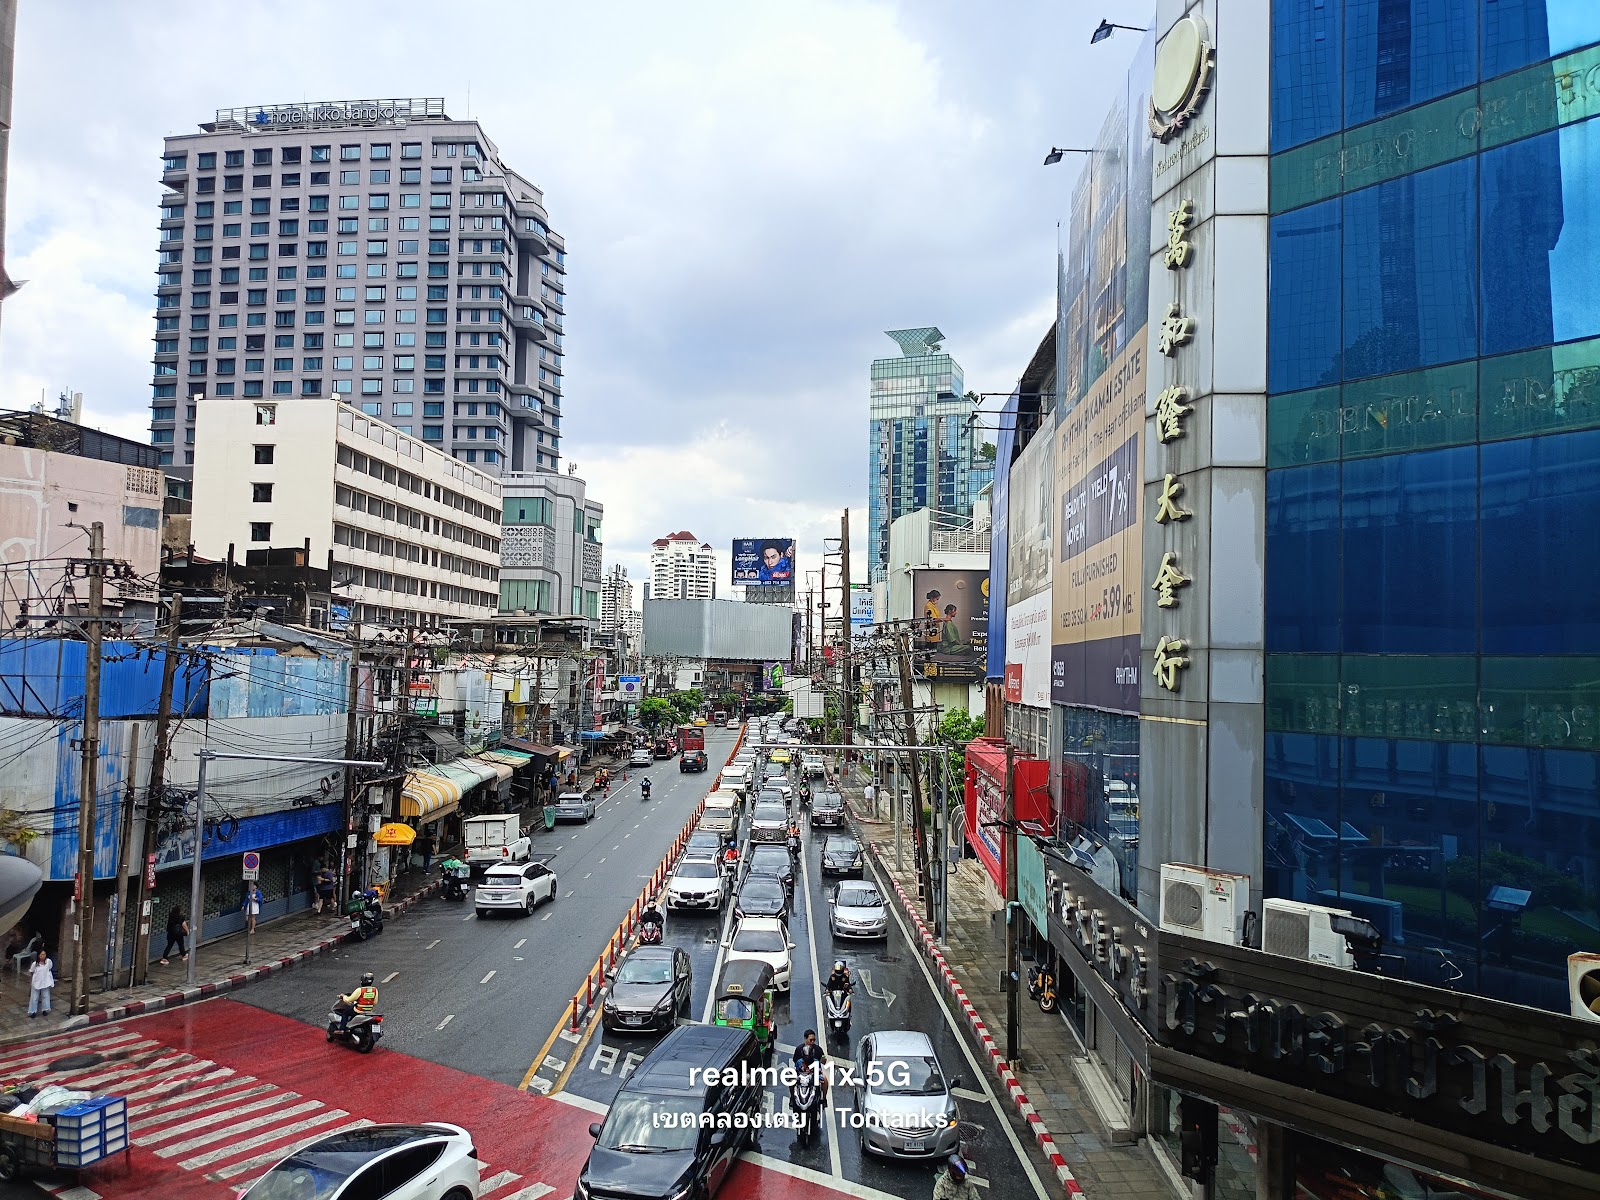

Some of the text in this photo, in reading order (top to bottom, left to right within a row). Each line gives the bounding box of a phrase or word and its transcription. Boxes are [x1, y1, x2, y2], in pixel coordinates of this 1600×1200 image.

[271, 107, 303, 124] hotel
[1114, 348, 1141, 399] ESTATE
[1311, 387, 1476, 438] DENTAL
[1091, 473, 1108, 500] YIELD
[1066, 523, 1079, 546] MOVE
[1085, 552, 1118, 582] FURNISHED
[1103, 584, 1121, 620] 5.99
[1115, 666, 1138, 685] RHYTHM
